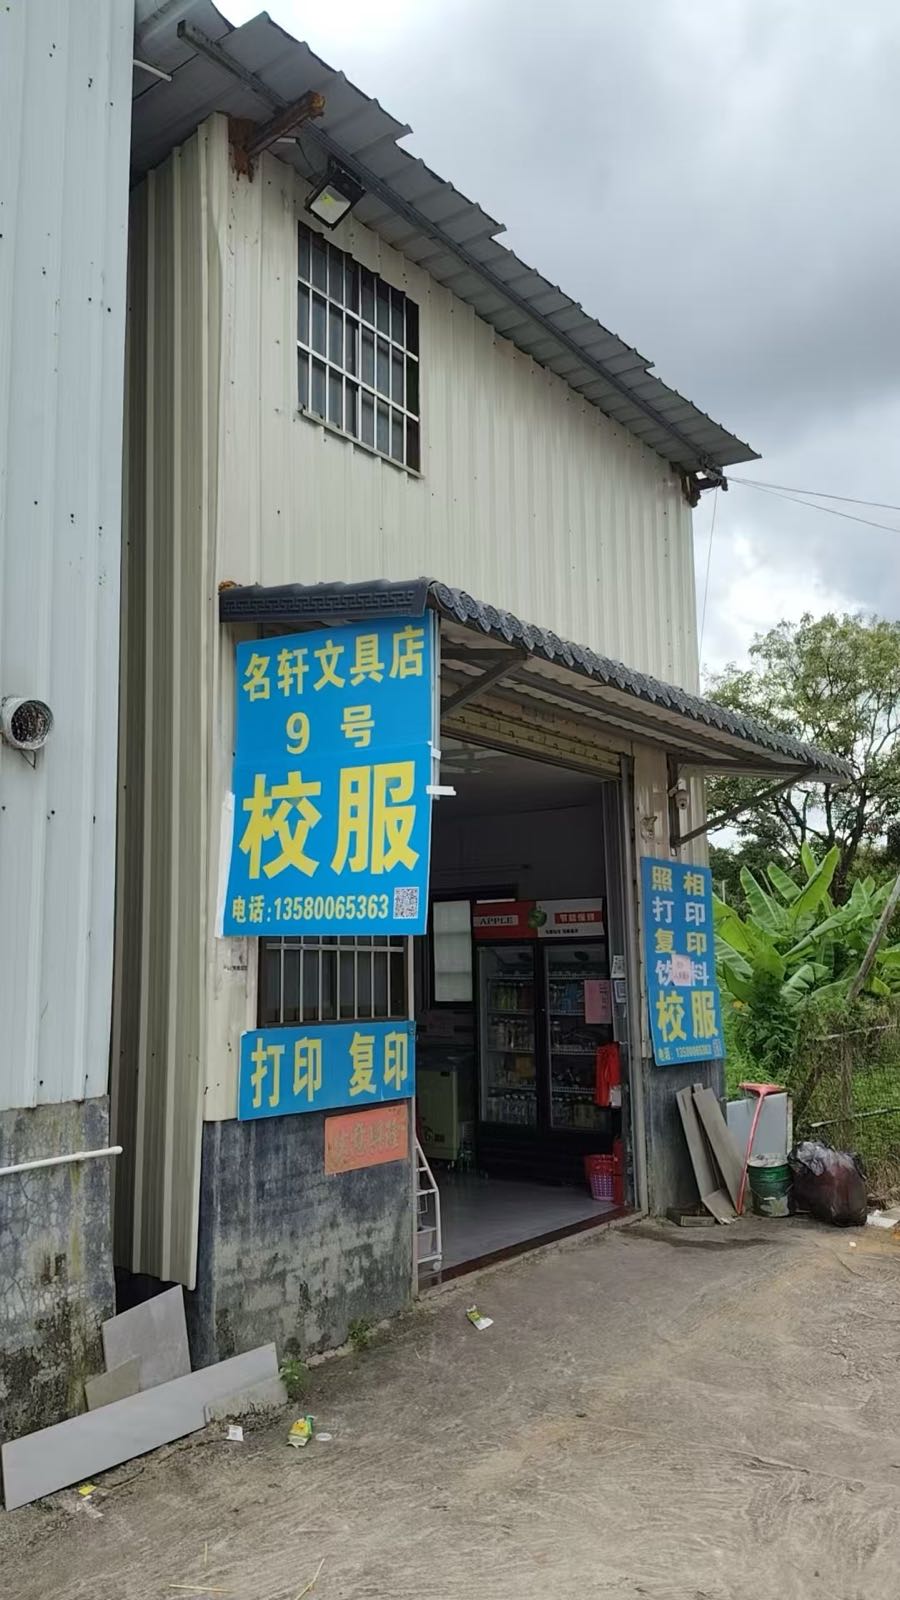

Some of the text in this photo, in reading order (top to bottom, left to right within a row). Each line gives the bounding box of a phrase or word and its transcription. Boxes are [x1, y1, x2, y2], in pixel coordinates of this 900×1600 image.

[243, 625, 425, 702] 名轩文具店
[238, 760, 420, 880] 校服
[651, 865, 705, 897] 照相
[479, 916, 514, 926] APPLE
[652, 896, 706, 926] 打印
[654, 928, 707, 956] 复印
[656, 990, 719, 1043] 校服
[251, 1031, 408, 1109] 打印 复印
